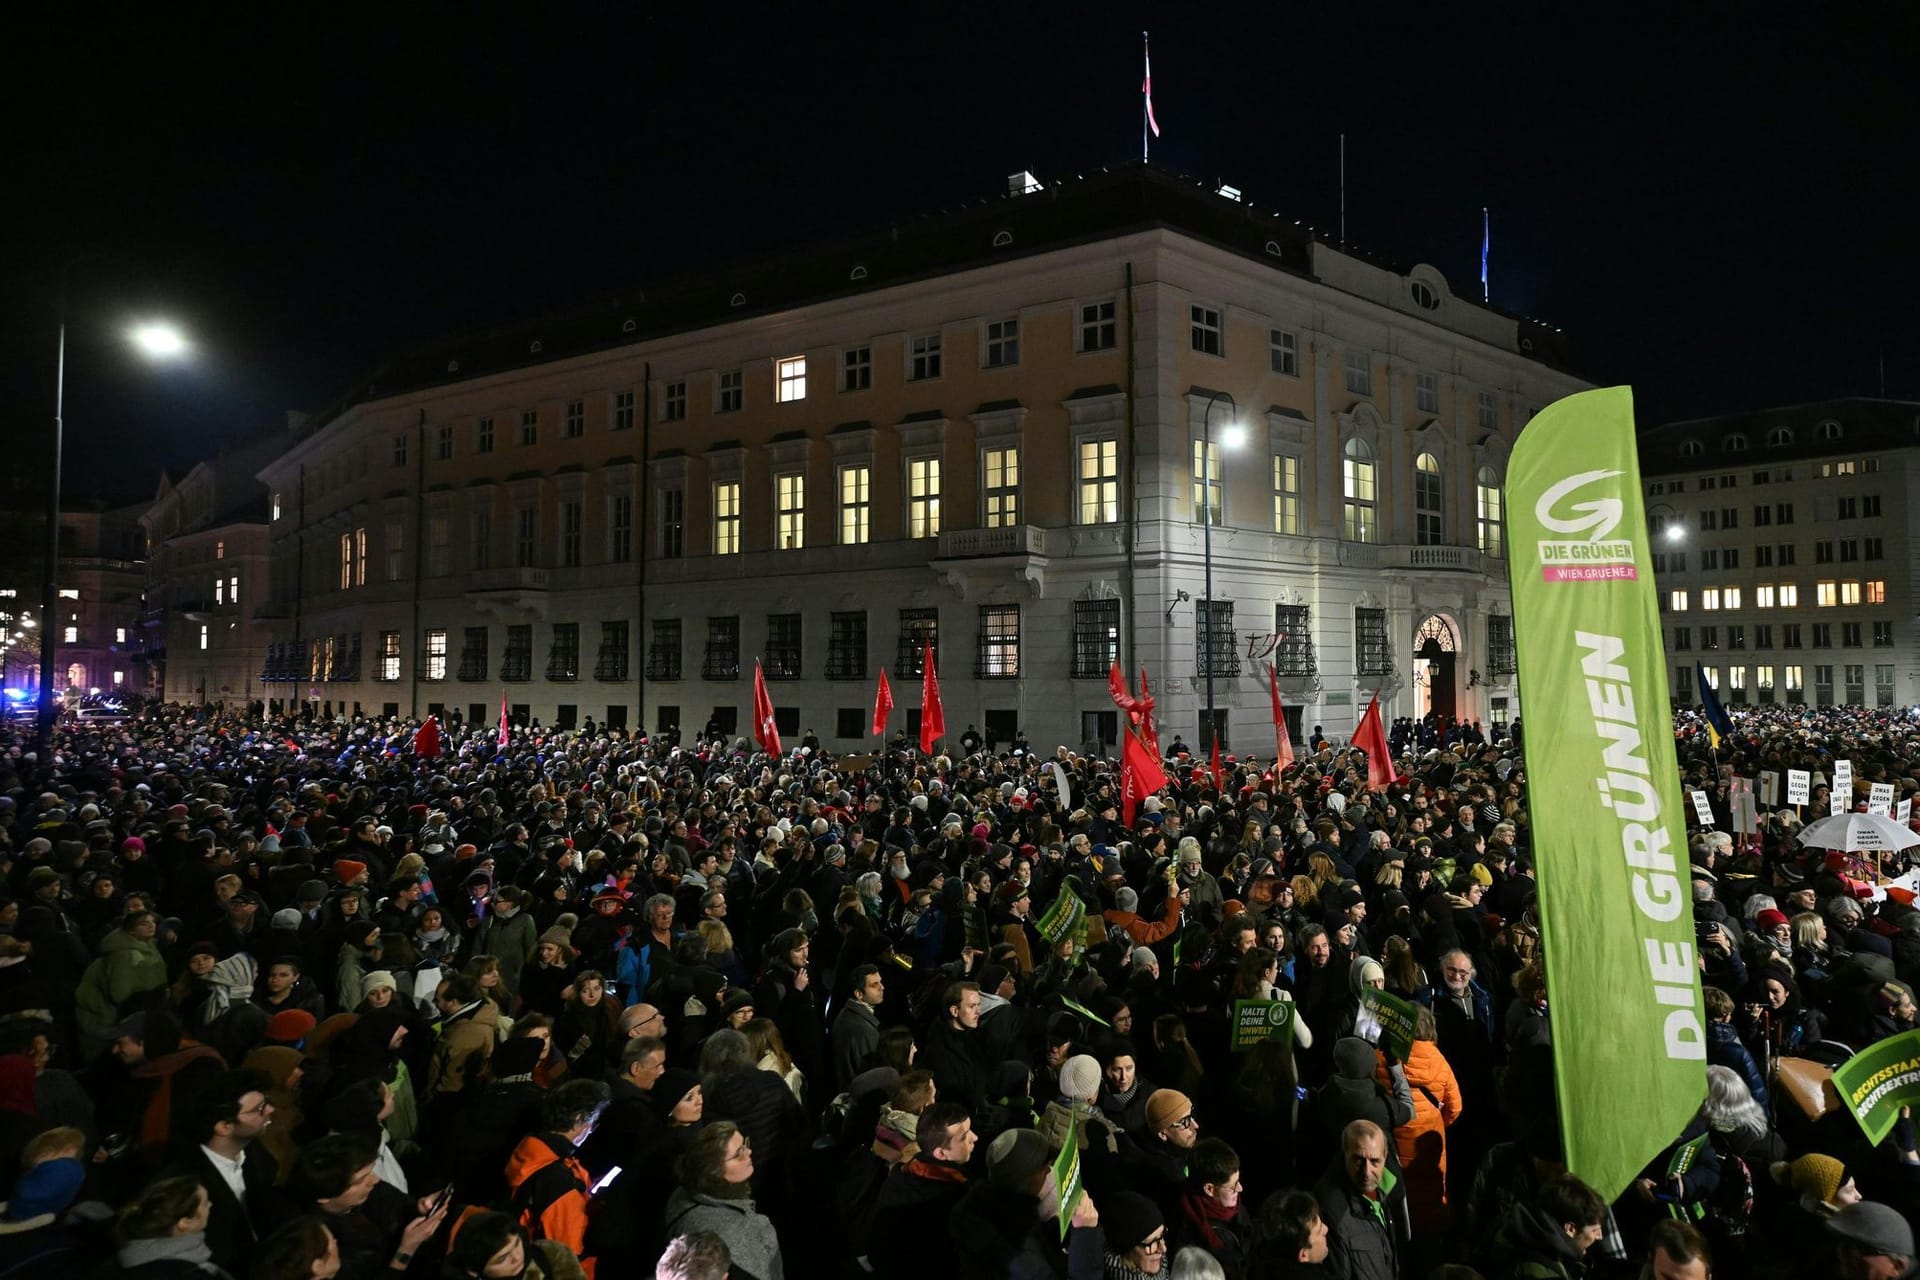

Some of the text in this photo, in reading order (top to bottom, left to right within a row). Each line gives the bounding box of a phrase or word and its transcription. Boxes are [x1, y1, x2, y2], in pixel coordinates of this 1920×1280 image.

[1543, 542, 1632, 559] DIE GRÜNEN
[1575, 630, 1706, 1060] DIE GRÜNEN
[1241, 1007, 1266, 1016] HALTE
[1240, 1017, 1265, 1026] DEINE
